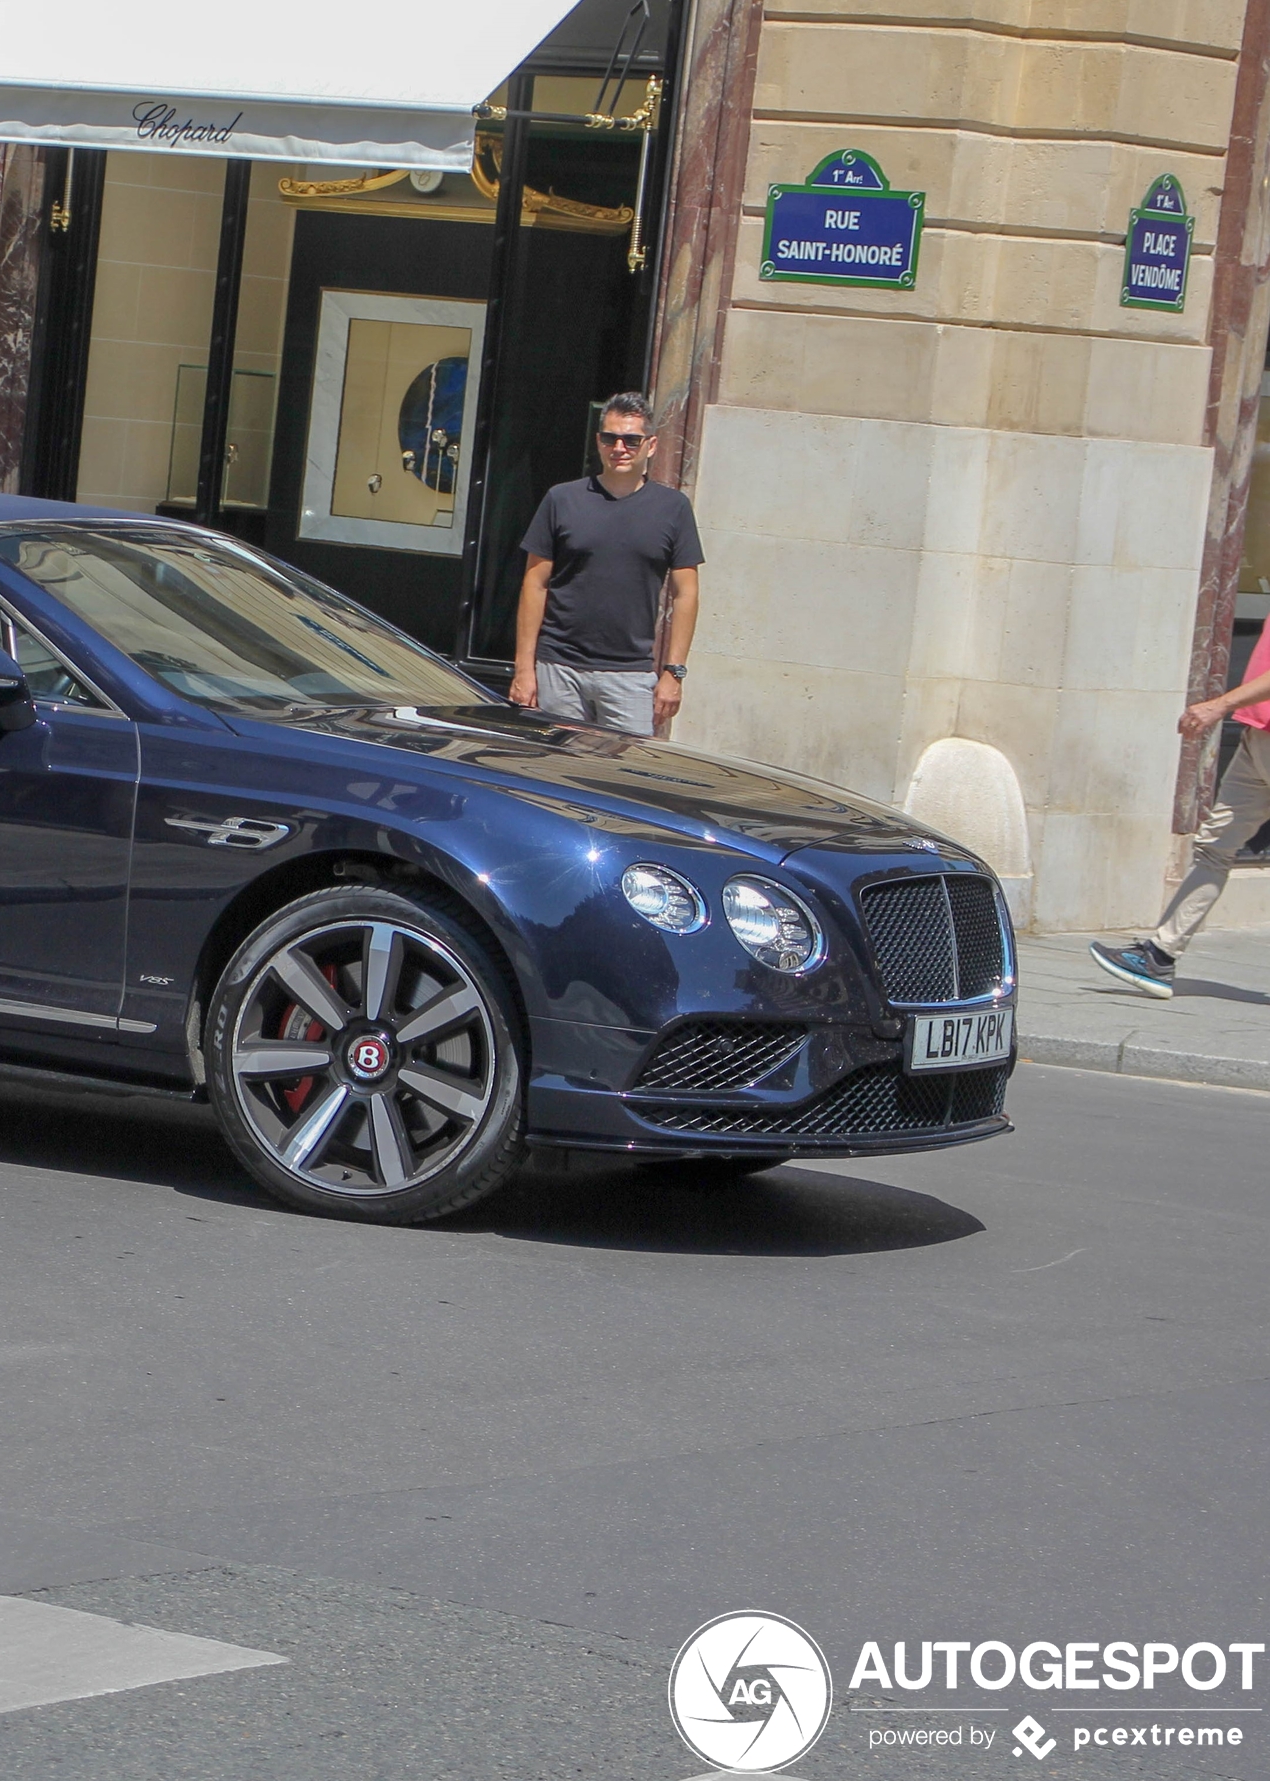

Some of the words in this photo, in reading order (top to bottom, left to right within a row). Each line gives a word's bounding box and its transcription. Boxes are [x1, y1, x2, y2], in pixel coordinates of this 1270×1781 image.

[132, 101, 244, 148] Chopard
[824, 210, 862, 231] RUE
[777, 240, 904, 266] SAINT-HONORÉ
[1142, 232, 1177, 257] PLACE
[1131, 263, 1182, 291] VENDÔME
[926, 1018, 973, 1059] LB17
[976, 1013, 1005, 1054] KPK
[358, 1045, 379, 1068] B
